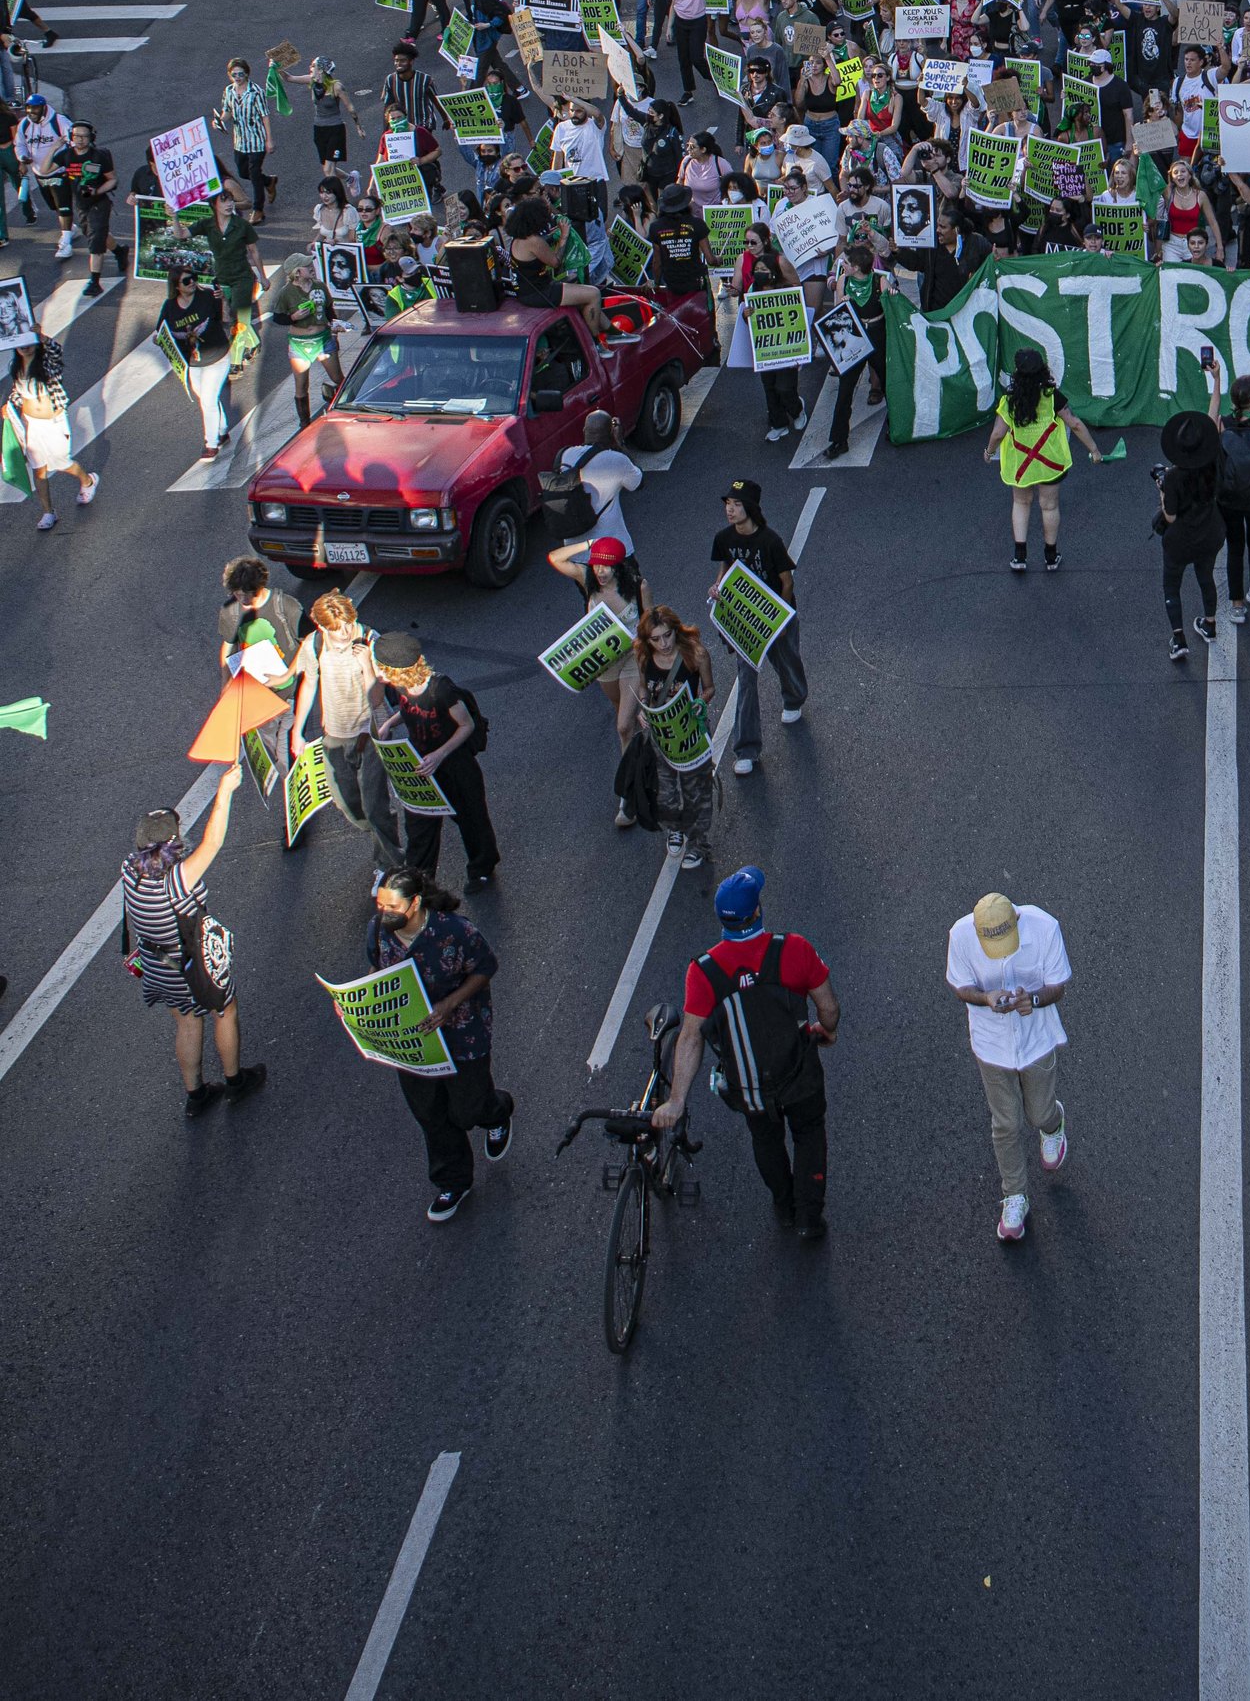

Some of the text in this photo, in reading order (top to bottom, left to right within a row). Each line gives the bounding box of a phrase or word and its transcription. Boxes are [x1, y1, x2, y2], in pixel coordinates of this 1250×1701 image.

[1187, 2, 1200, 15] WE
[804, 26, 813, 34] NO
[1194, 18, 1210, 30] GO
[908, 26, 946, 36] OVARIES!
[1180, 29, 1217, 42] BACK
[797, 34, 820, 44] FORCED
[552, 53, 597, 68] ABORT
[926, 61, 957, 70] ABORT
[565, 68, 579, 77] THE
[925, 73, 962, 84] SUPREME
[555, 84, 591, 94] COURT
[925, 82, 957, 92] COURT
[970, 133, 1018, 153] OVERTURN
[163, 159, 181, 172] YOU
[972, 151, 994, 168] ROE
[165, 162, 192, 182] CARE IF
[165, 162, 209, 199] WOMEN
[382, 177, 417, 189] SOLICITUD
[389, 188, 423, 201] SIN PEDIR
[711, 211, 744, 219] STOP the
[1095, 206, 1142, 218] OVERTURN
[710, 220, 746, 231] Supreme
[777, 214, 801, 233] AMERICA
[1100, 221, 1125, 235] ROE
[717, 229, 739, 239] Court
[613, 236, 632, 257] ROE
[795, 237, 818, 254] WOMEN
[756, 310, 785, 330] ROE
[755, 330, 806, 349] HELL NO!
[328, 549, 367, 562] 5U61125
[732, 576, 781, 621] ABORTION
[720, 586, 773, 640] ON DEMAND
[725, 607, 763, 649] WITHOUT
[720, 614, 755, 656] APOLOGY
[547, 613, 614, 672] OVERTURN
[568, 654, 609, 684] ROE
[372, 976, 400, 998] the
[357, 1013, 400, 1029] Court
